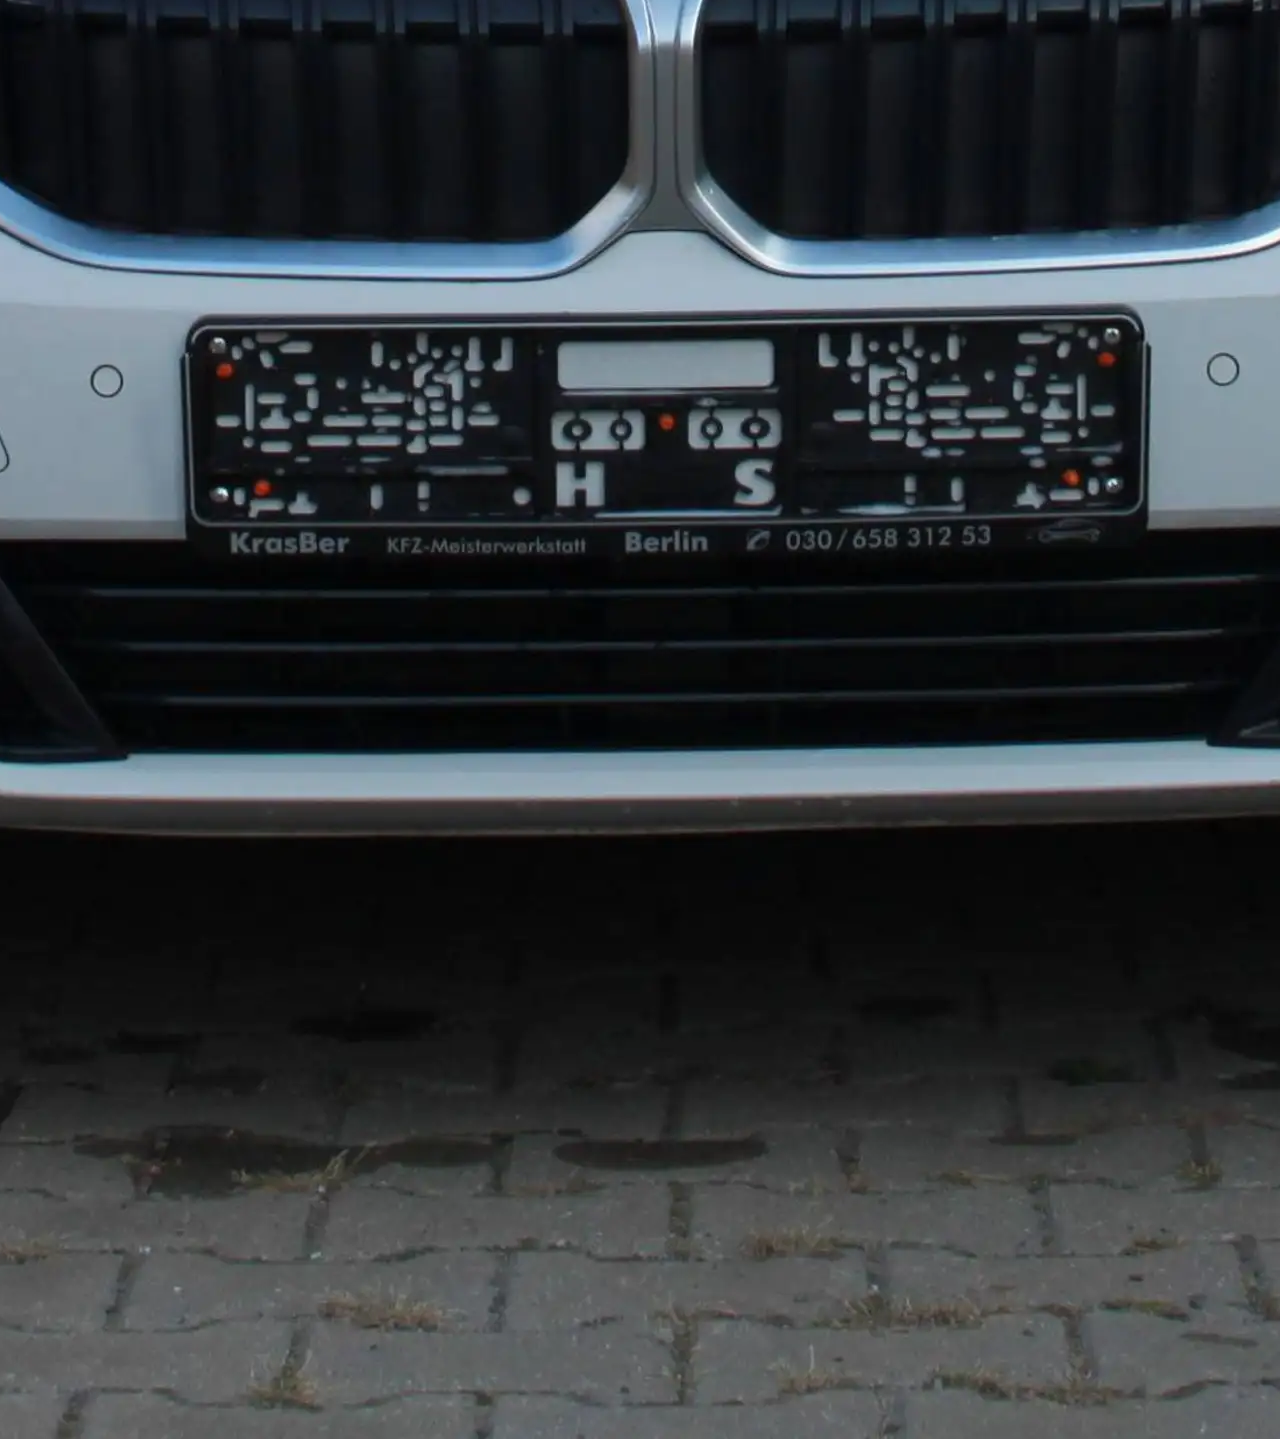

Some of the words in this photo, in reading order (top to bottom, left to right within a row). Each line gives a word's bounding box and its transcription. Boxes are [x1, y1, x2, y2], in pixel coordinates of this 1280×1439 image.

[229, 531, 350, 554] KrasBer
[386, 536, 587, 555] KFZ-Meisterwerkstatt
[624, 530, 709, 553] Berlin
[907, 525, 952, 548] 312
[961, 525, 992, 547] 53
